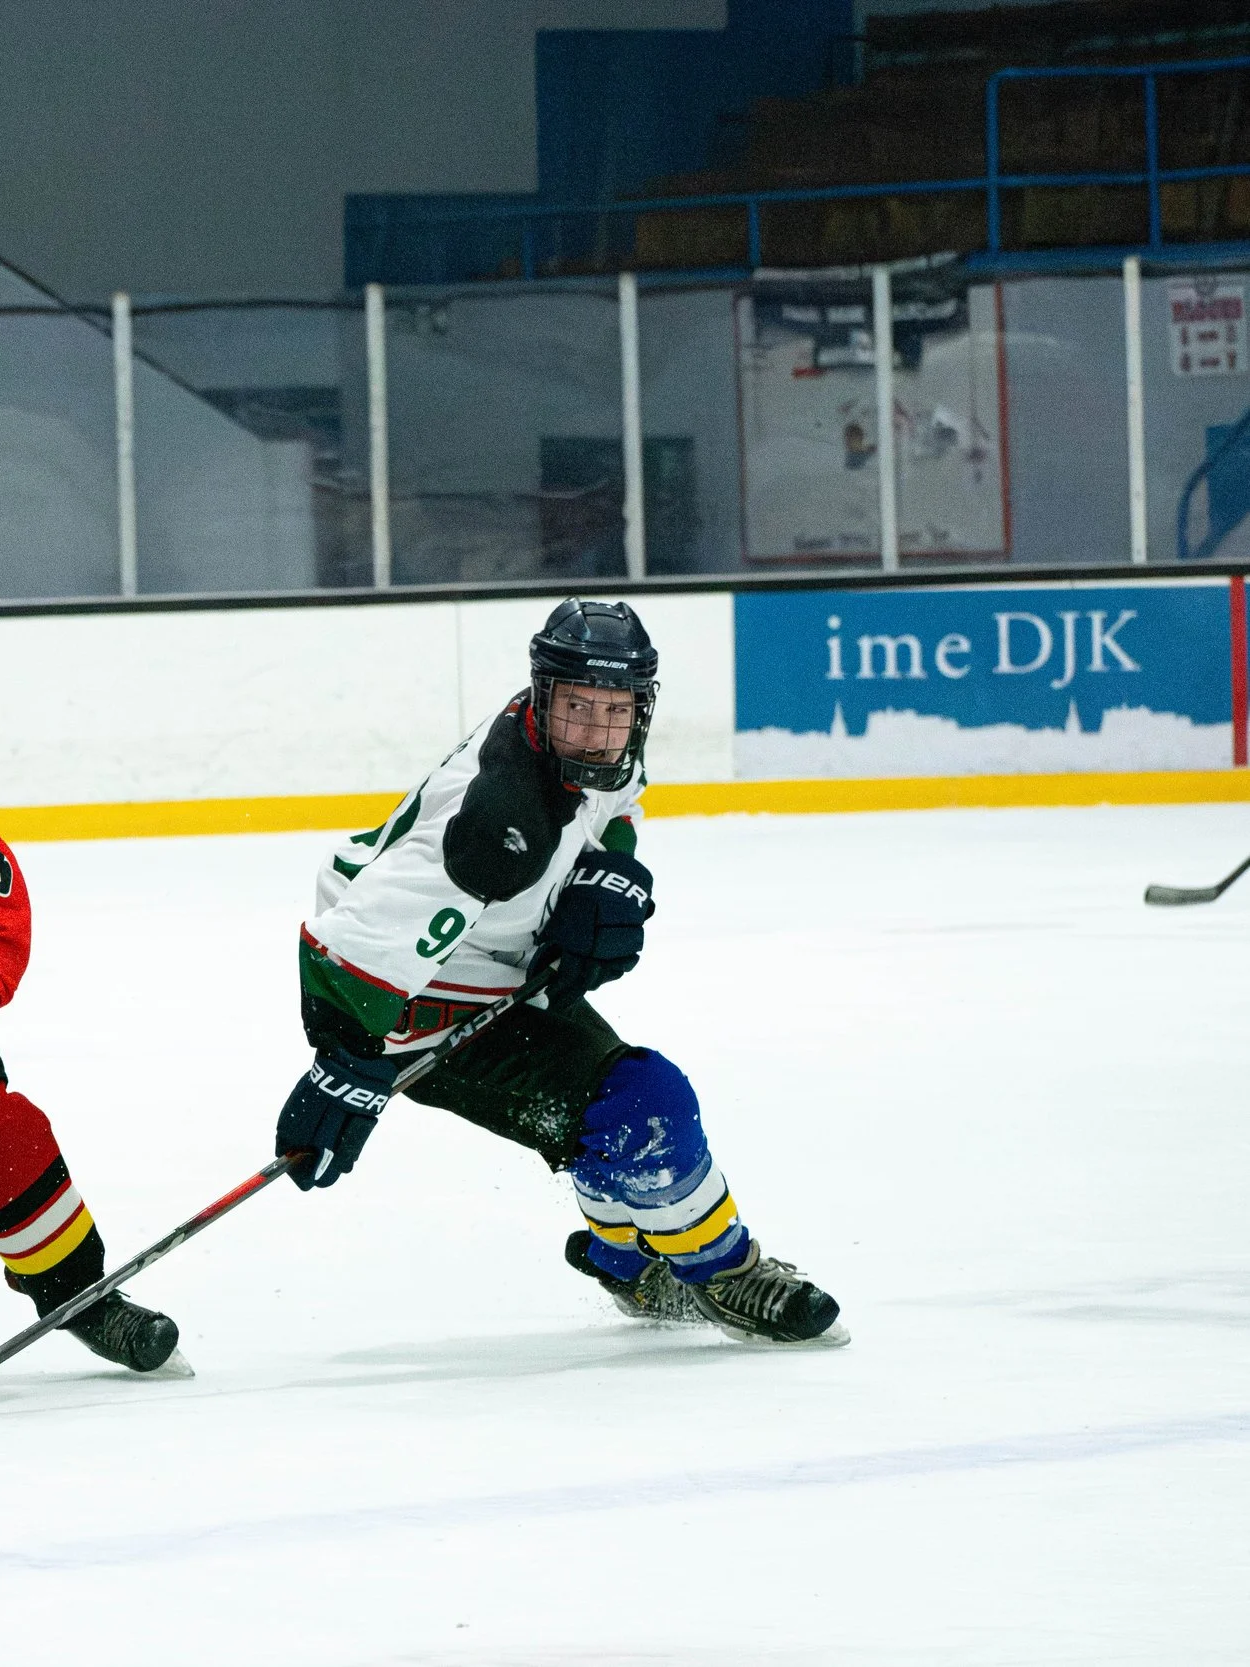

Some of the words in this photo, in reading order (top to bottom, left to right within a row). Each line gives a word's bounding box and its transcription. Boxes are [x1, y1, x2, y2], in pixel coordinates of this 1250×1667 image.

[826, 615, 972, 679] ime
[993, 610, 1141, 689] DJK
[449, 994, 515, 1048] CCM
[310, 1062, 389, 1113] AUER
